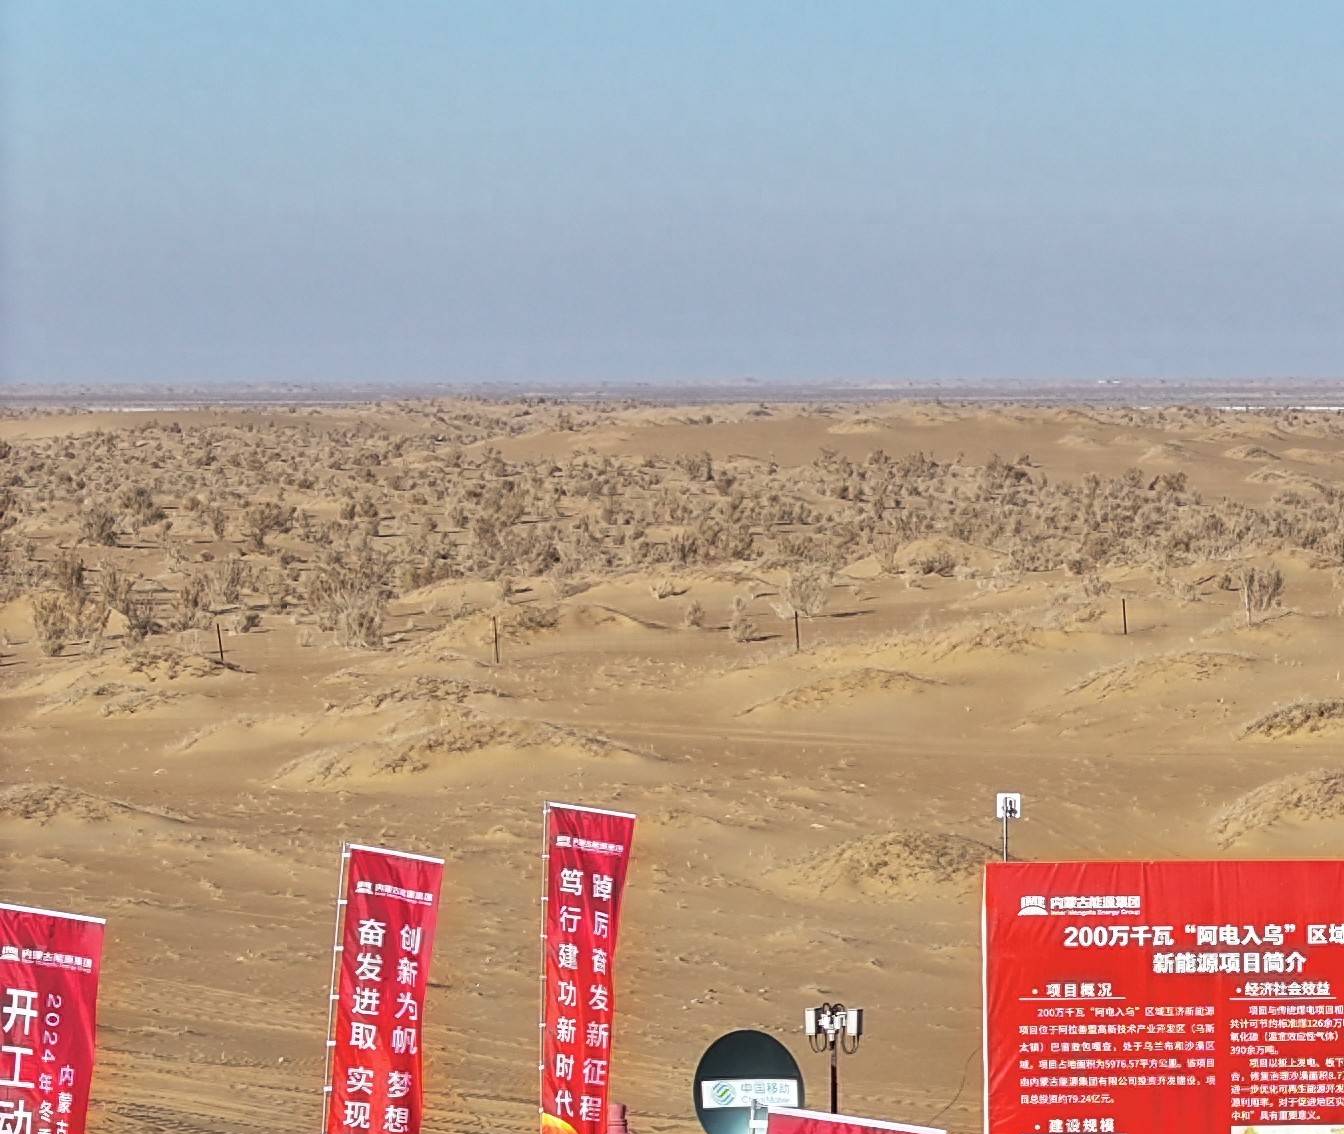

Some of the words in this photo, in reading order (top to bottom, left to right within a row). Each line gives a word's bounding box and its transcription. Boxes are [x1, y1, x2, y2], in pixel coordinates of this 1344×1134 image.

[1152, 951, 1307, 974] 新能源项目简介
[554, 867, 585, 1117] 笃行建功新时代
[1046, 982, 1113, 997] 项目概况
[1244, 981, 1331, 996] 经济社会效益
[579, 873, 614, 1122] 踔厉奋发新征程
[741, 1082, 790, 1094] 中国移动
[1048, 1117, 1115, 1133] 建设规模
